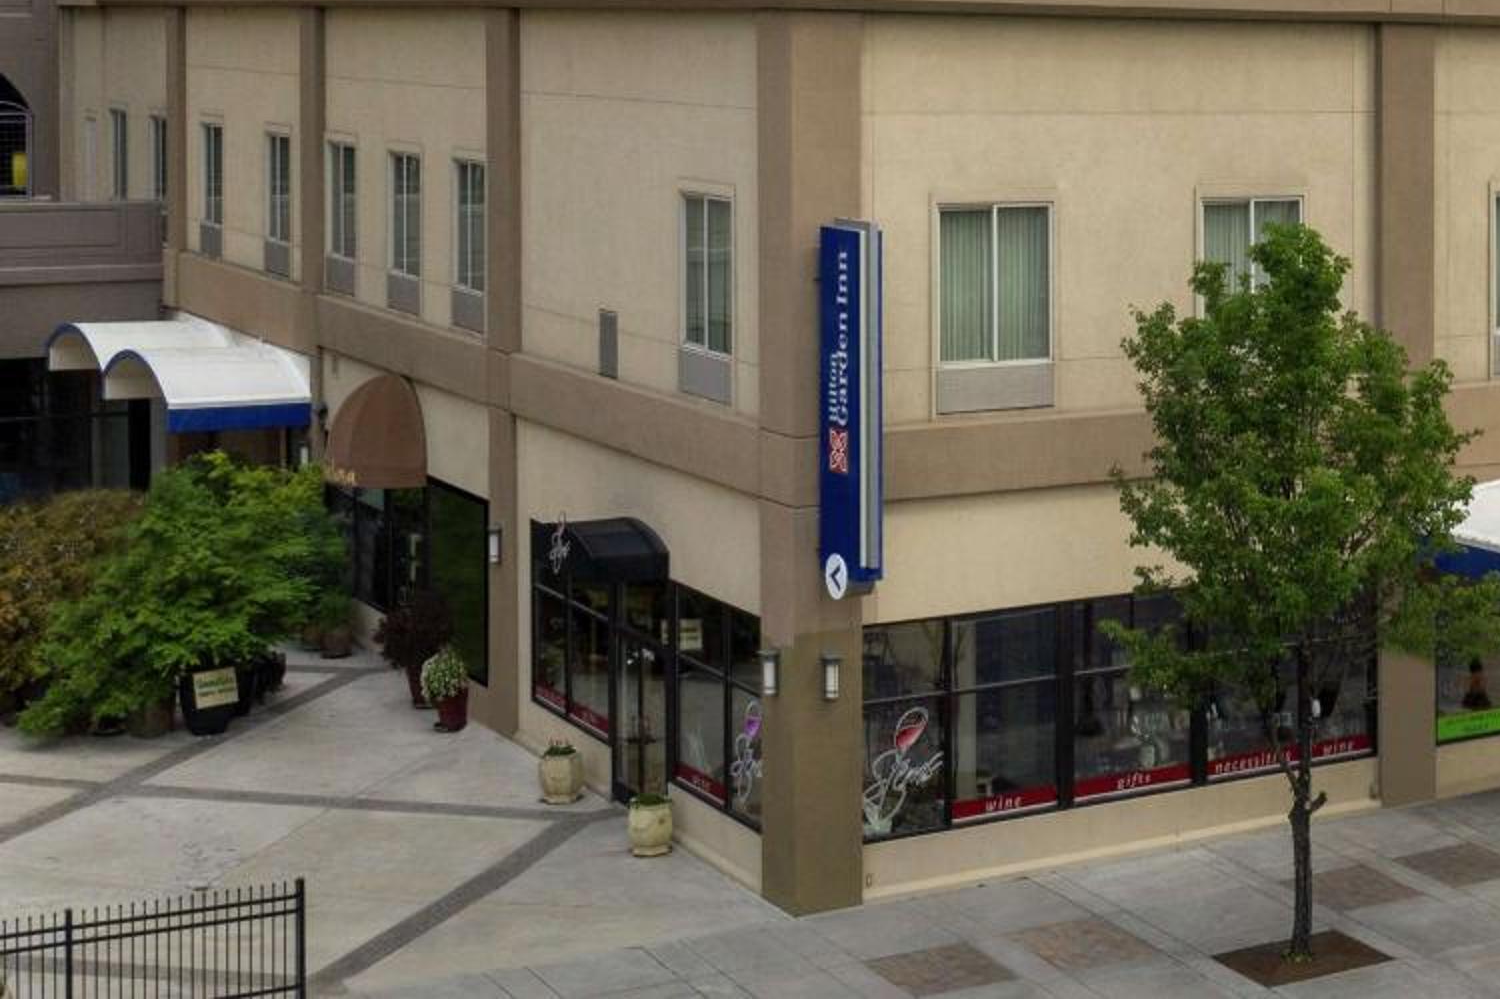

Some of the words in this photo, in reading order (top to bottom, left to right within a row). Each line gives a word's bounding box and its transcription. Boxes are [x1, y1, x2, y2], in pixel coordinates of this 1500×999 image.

[836, 251, 849, 304] Inn
[837, 312, 849, 427] Garden
[1323, 740, 1356, 756] wine
[1116, 771, 1152, 790] gifts
[984, 795, 1023, 812] wine
